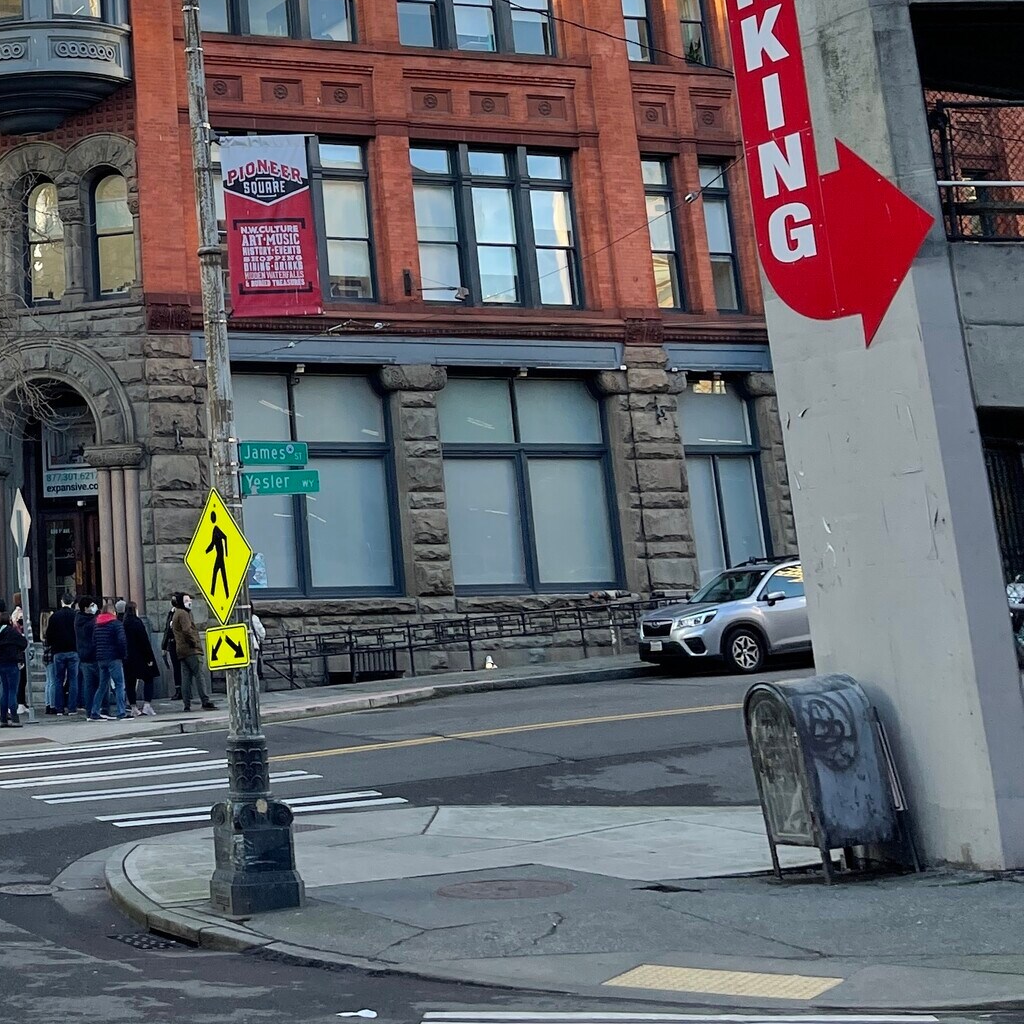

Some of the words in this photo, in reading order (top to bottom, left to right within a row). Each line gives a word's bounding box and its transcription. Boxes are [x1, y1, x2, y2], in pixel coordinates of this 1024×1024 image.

[227, 159, 303, 186] PIONEER
[243, 180, 286, 195] SQUARE
[266, 271, 304, 279] WATERFALLS
[244, 445, 286, 460] James
[294, 452, 302, 461] ST
[246, 474, 289, 489] Yesler
[302, 479, 314, 488] WY
